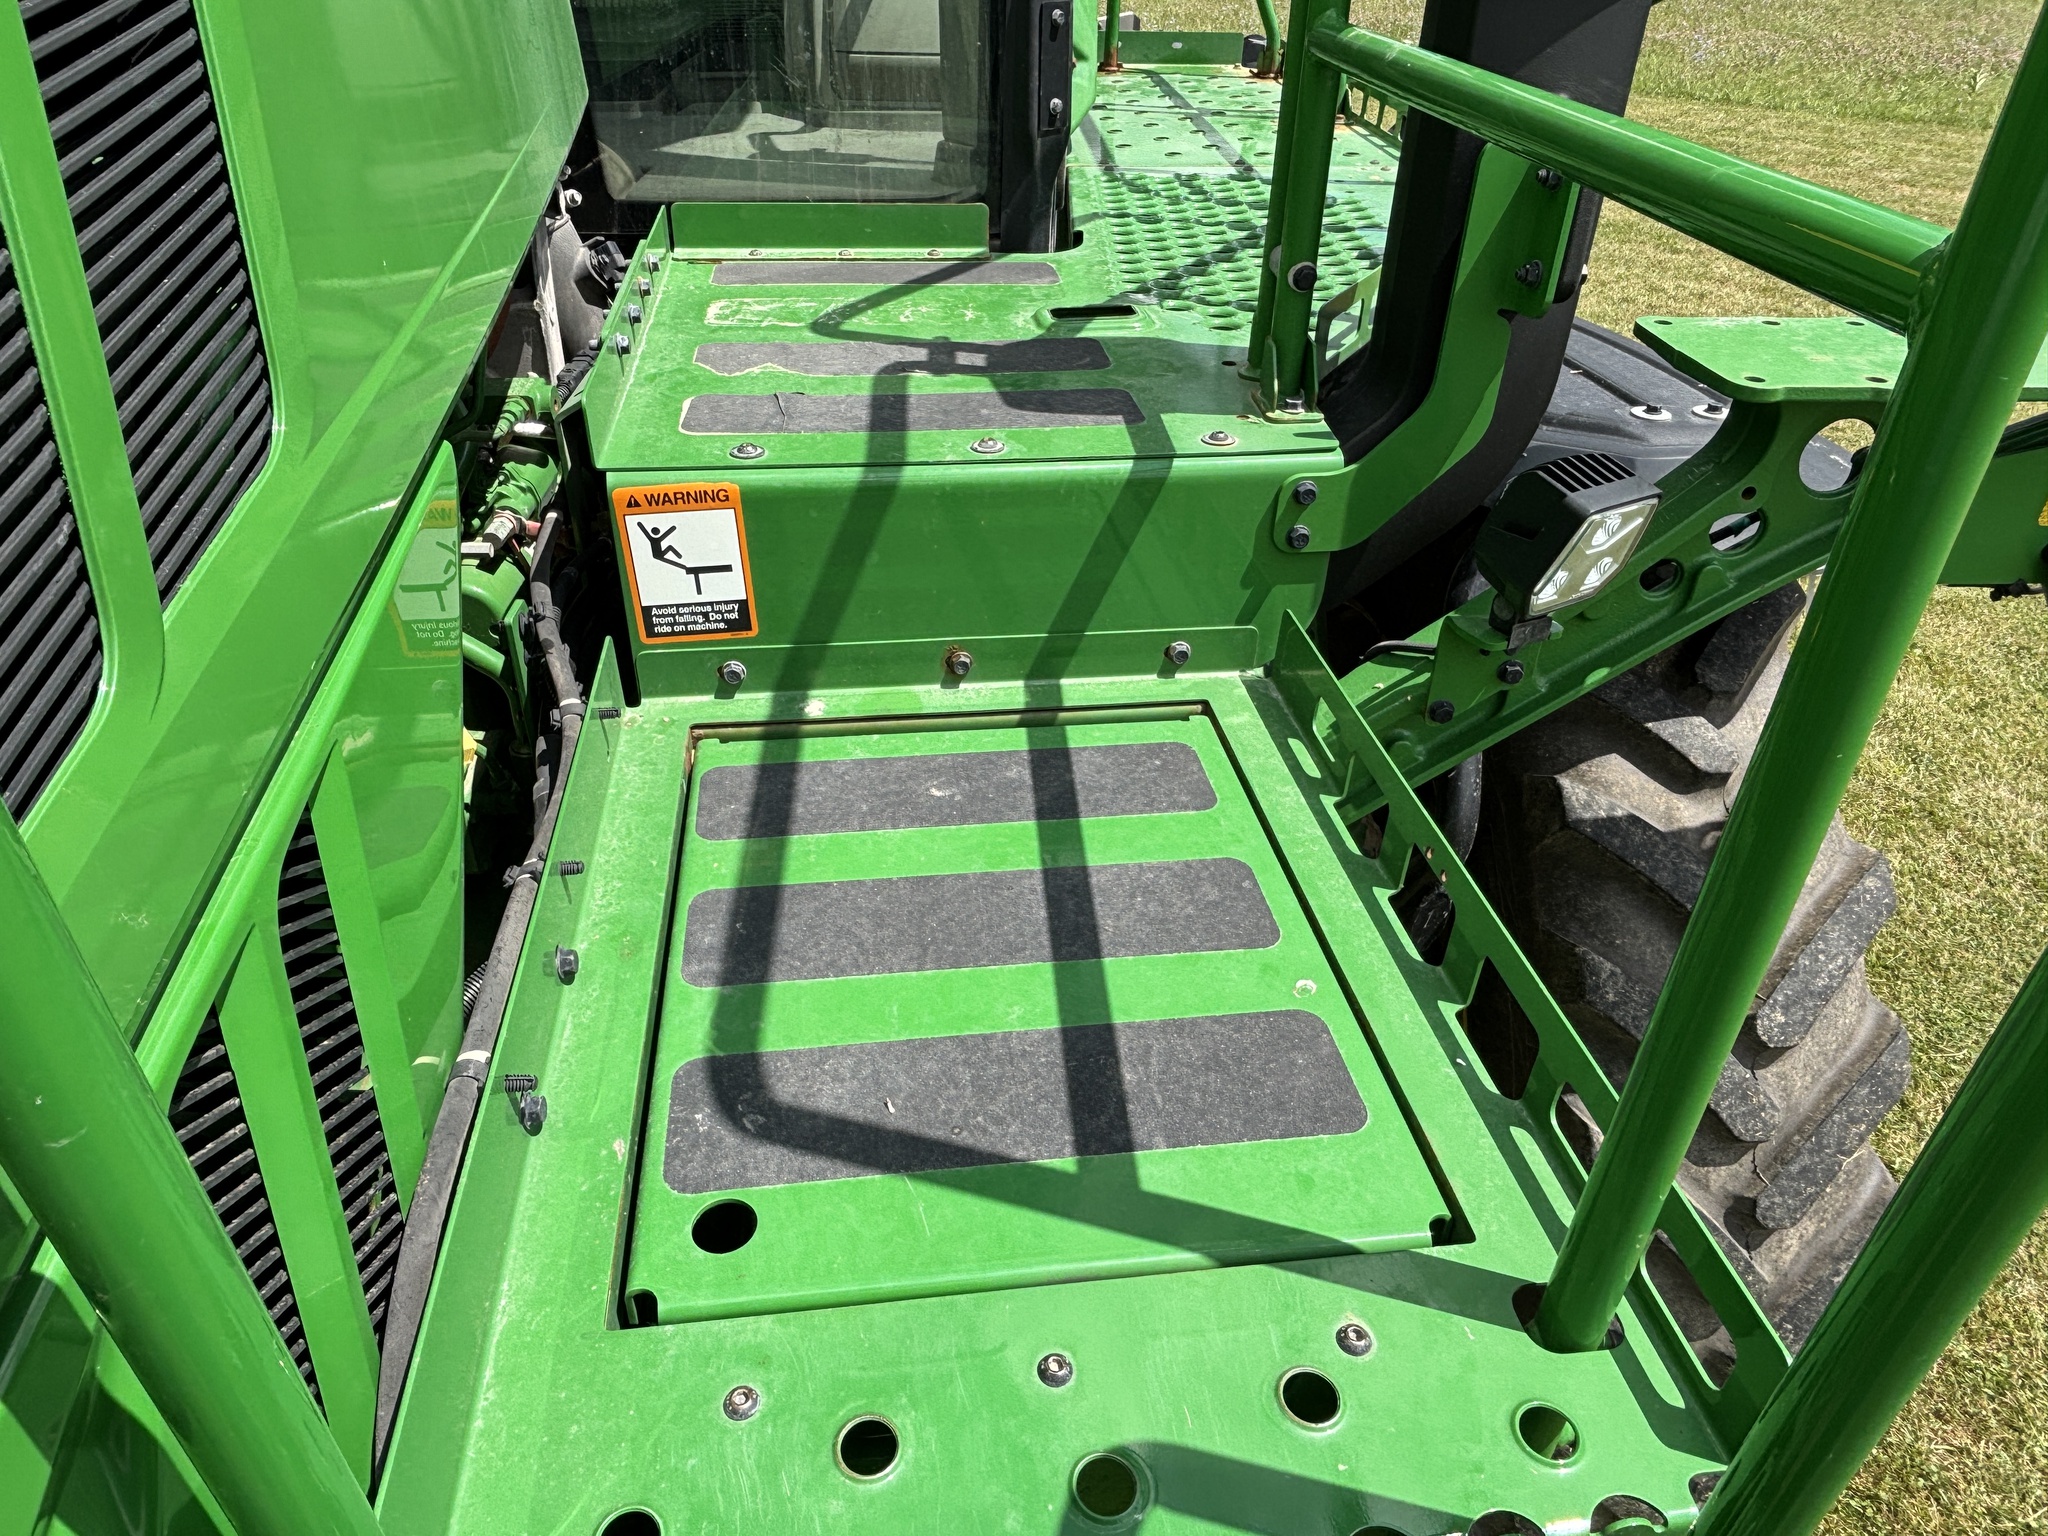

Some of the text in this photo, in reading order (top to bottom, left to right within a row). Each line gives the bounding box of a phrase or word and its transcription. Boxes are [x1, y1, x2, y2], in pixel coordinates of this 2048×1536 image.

[644, 488, 730, 507] WARNING
[651, 602, 739, 615] Avoid serious injury
[652, 611, 739, 624] from falling. Do not
[654, 625, 672, 633] ride
[687, 622, 728, 631] machine.
